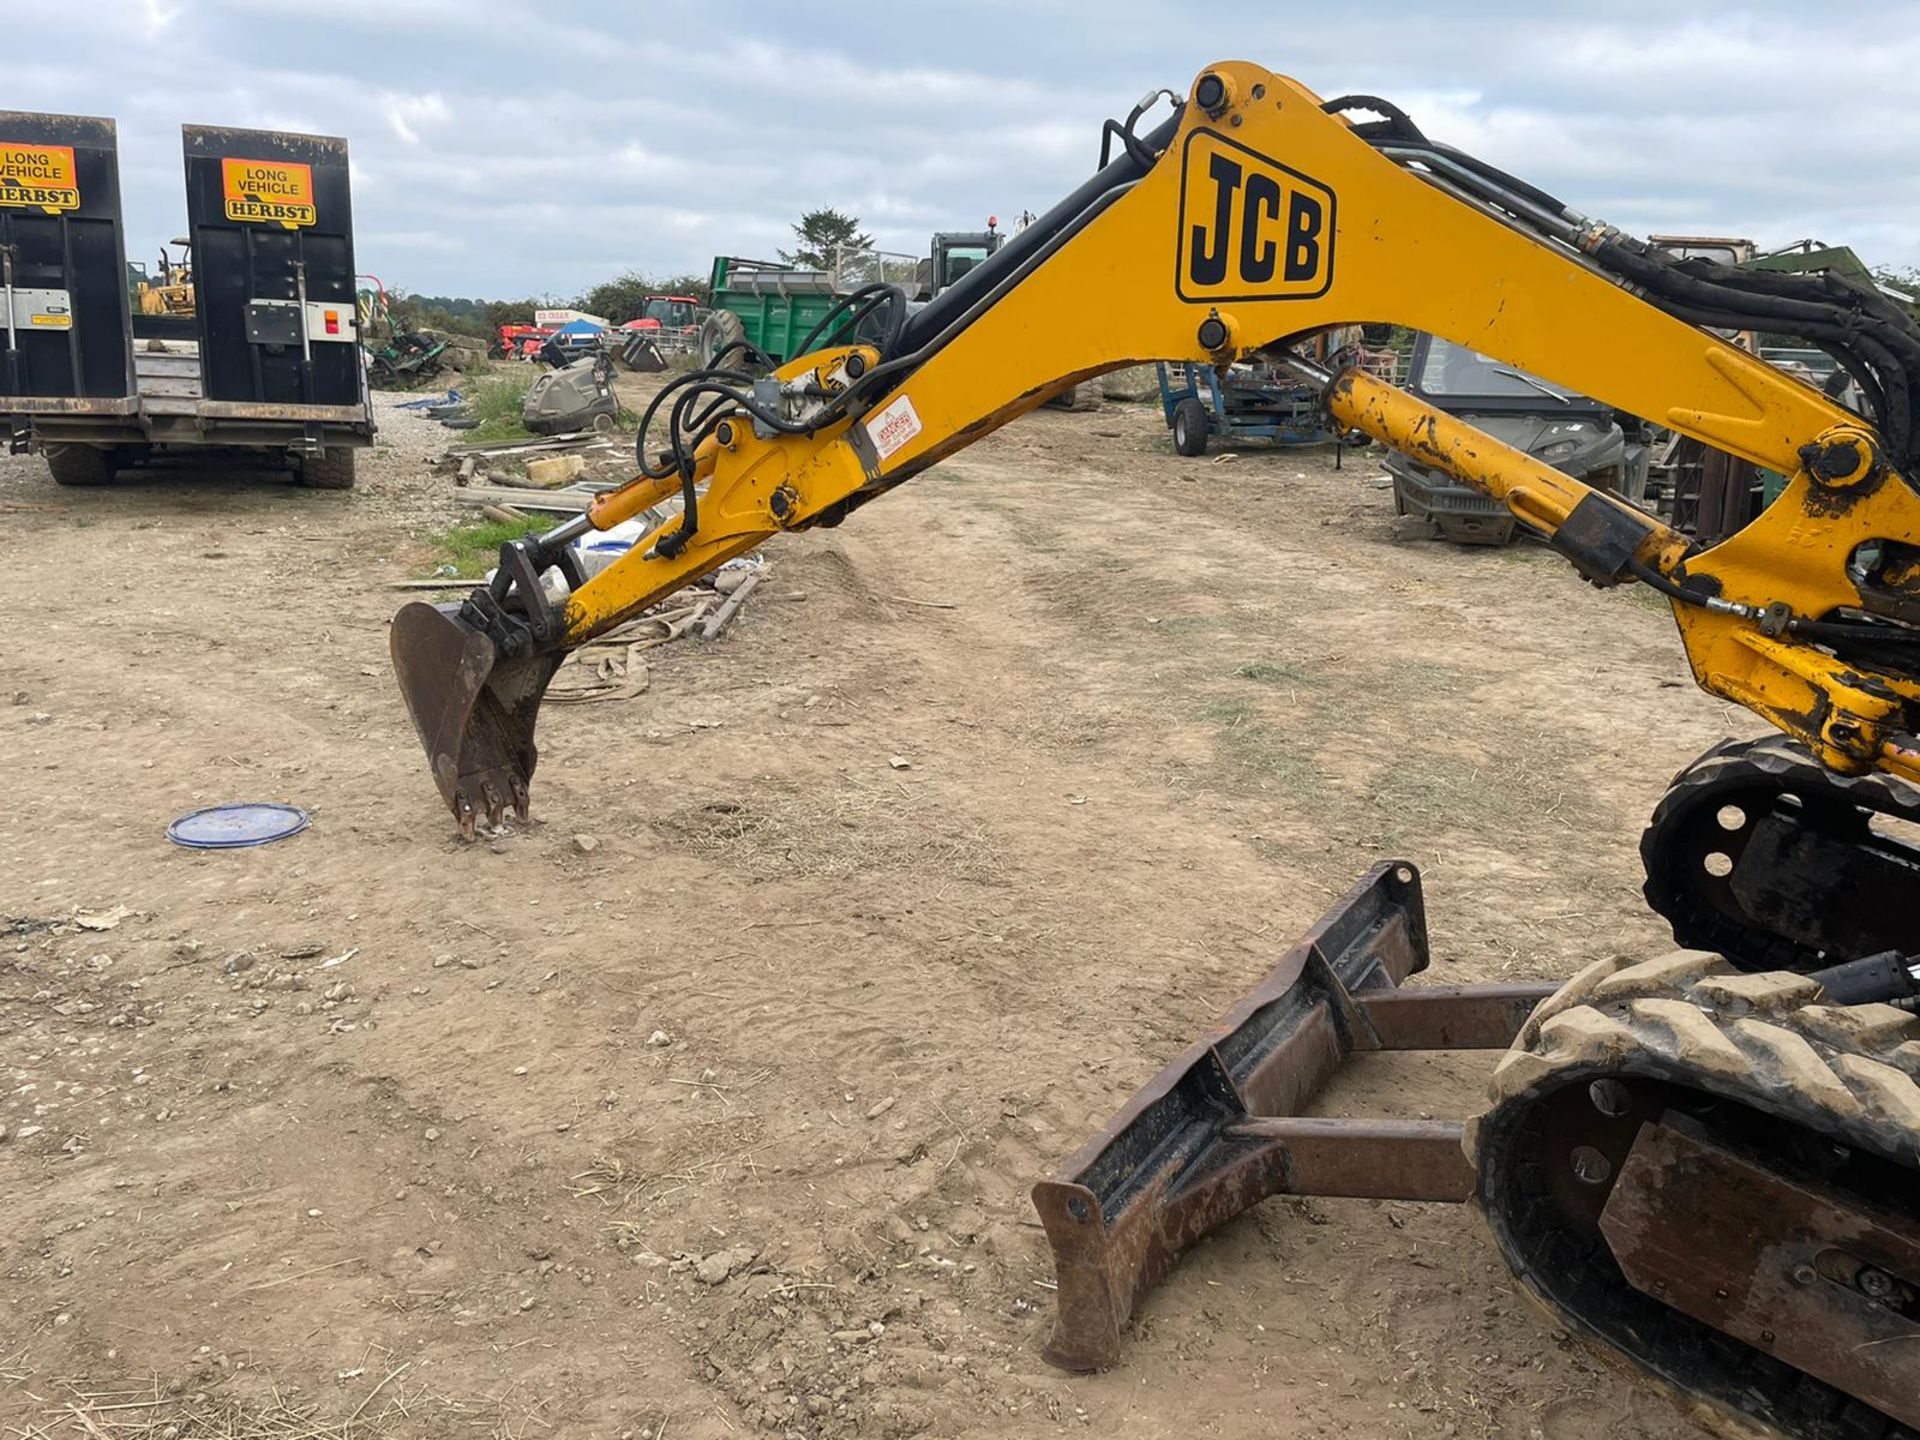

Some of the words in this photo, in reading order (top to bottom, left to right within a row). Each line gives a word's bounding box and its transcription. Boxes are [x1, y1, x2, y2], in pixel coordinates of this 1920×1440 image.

[6, 152, 49, 165] LONG
[246, 168, 287, 182] LONG
[238, 180, 299, 195] VEHICLE
[0, 188, 73, 204] ERBST
[231, 202, 310, 219] HERBST
[1190, 151, 1322, 286] JCB
